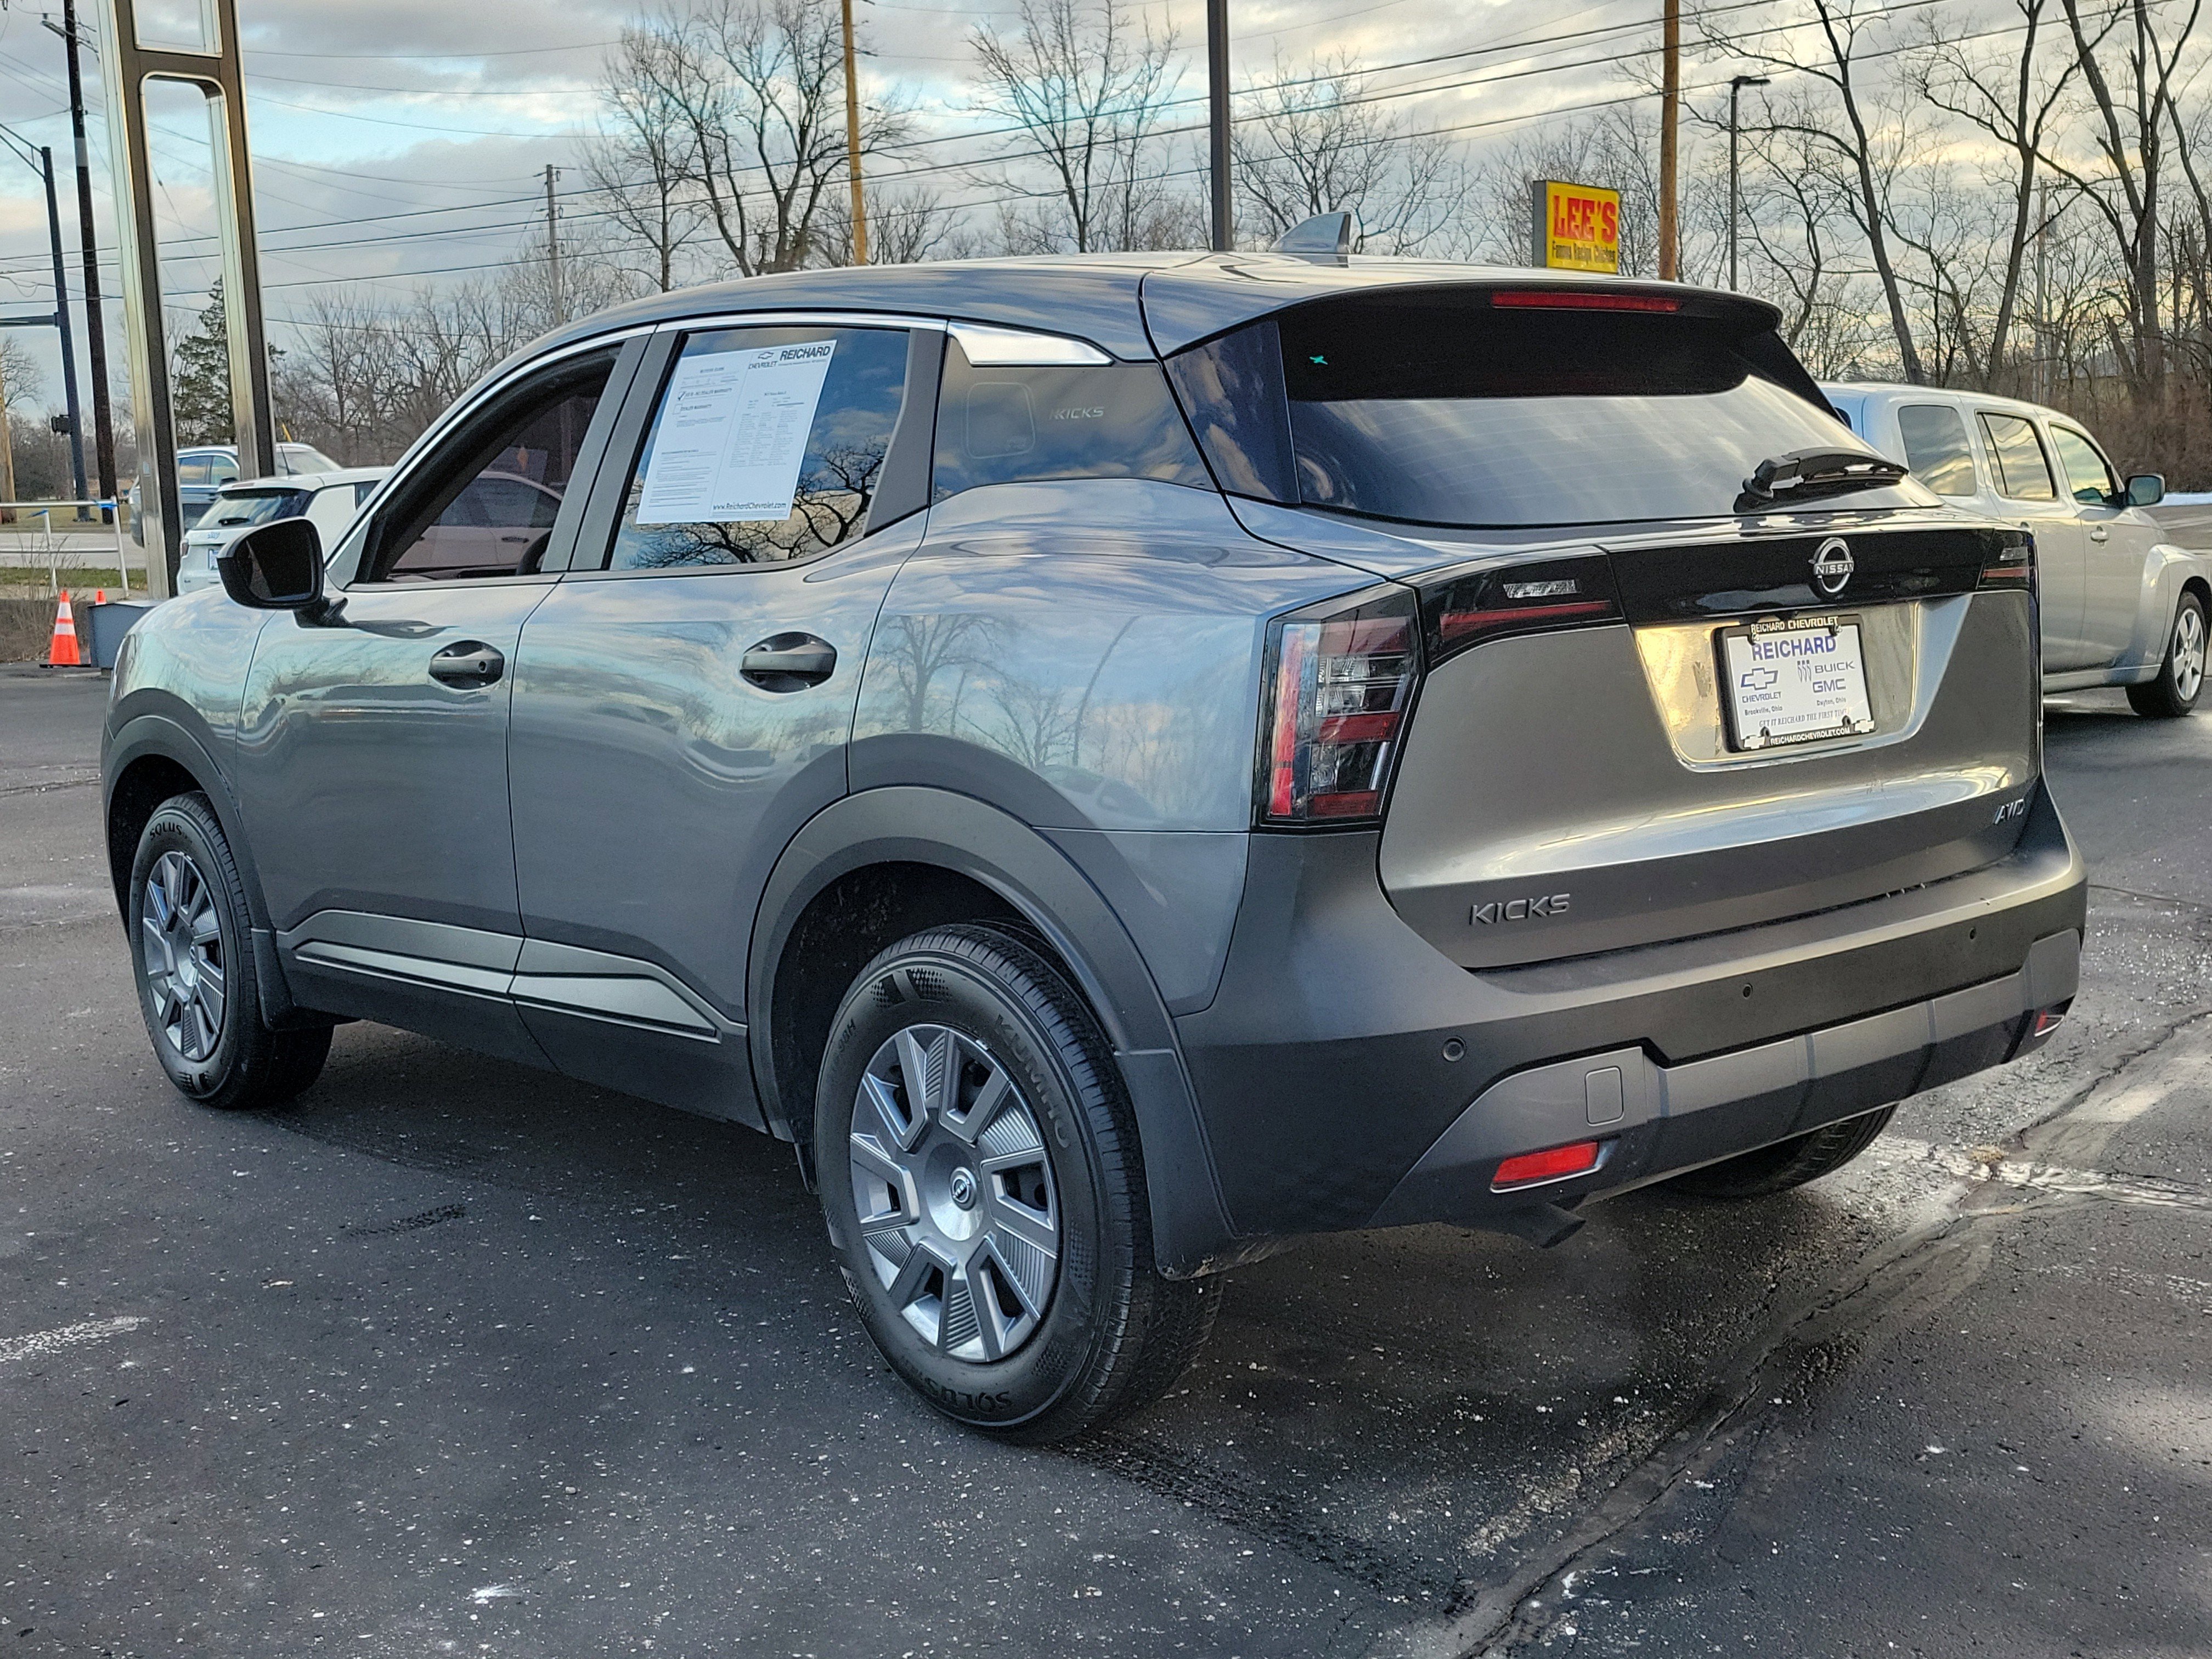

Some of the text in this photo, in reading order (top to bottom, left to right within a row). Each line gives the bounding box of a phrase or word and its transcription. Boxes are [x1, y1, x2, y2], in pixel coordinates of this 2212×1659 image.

[1554, 195, 1616, 244] LEE'S
[780, 346, 831, 361] REICHARD
[748, 360, 777, 370] CHEVROLET
[1053, 407, 1105, 420] KICKS
[1815, 563, 1853, 574] NISSAN
[1751, 616, 1838, 633] REICHARD CHEVROLET
[1752, 635, 1836, 661] REICHARD
[1815, 661, 1855, 674] BUICK
[1812, 679, 1847, 693] GMC
[1742, 691, 1782, 703] CHEVROLET
[1770, 727, 1850, 746] REICHARDCHEVROLET.COM
[149, 822, 183, 841] SOLUS
[1469, 893, 1570, 925] KICKS
